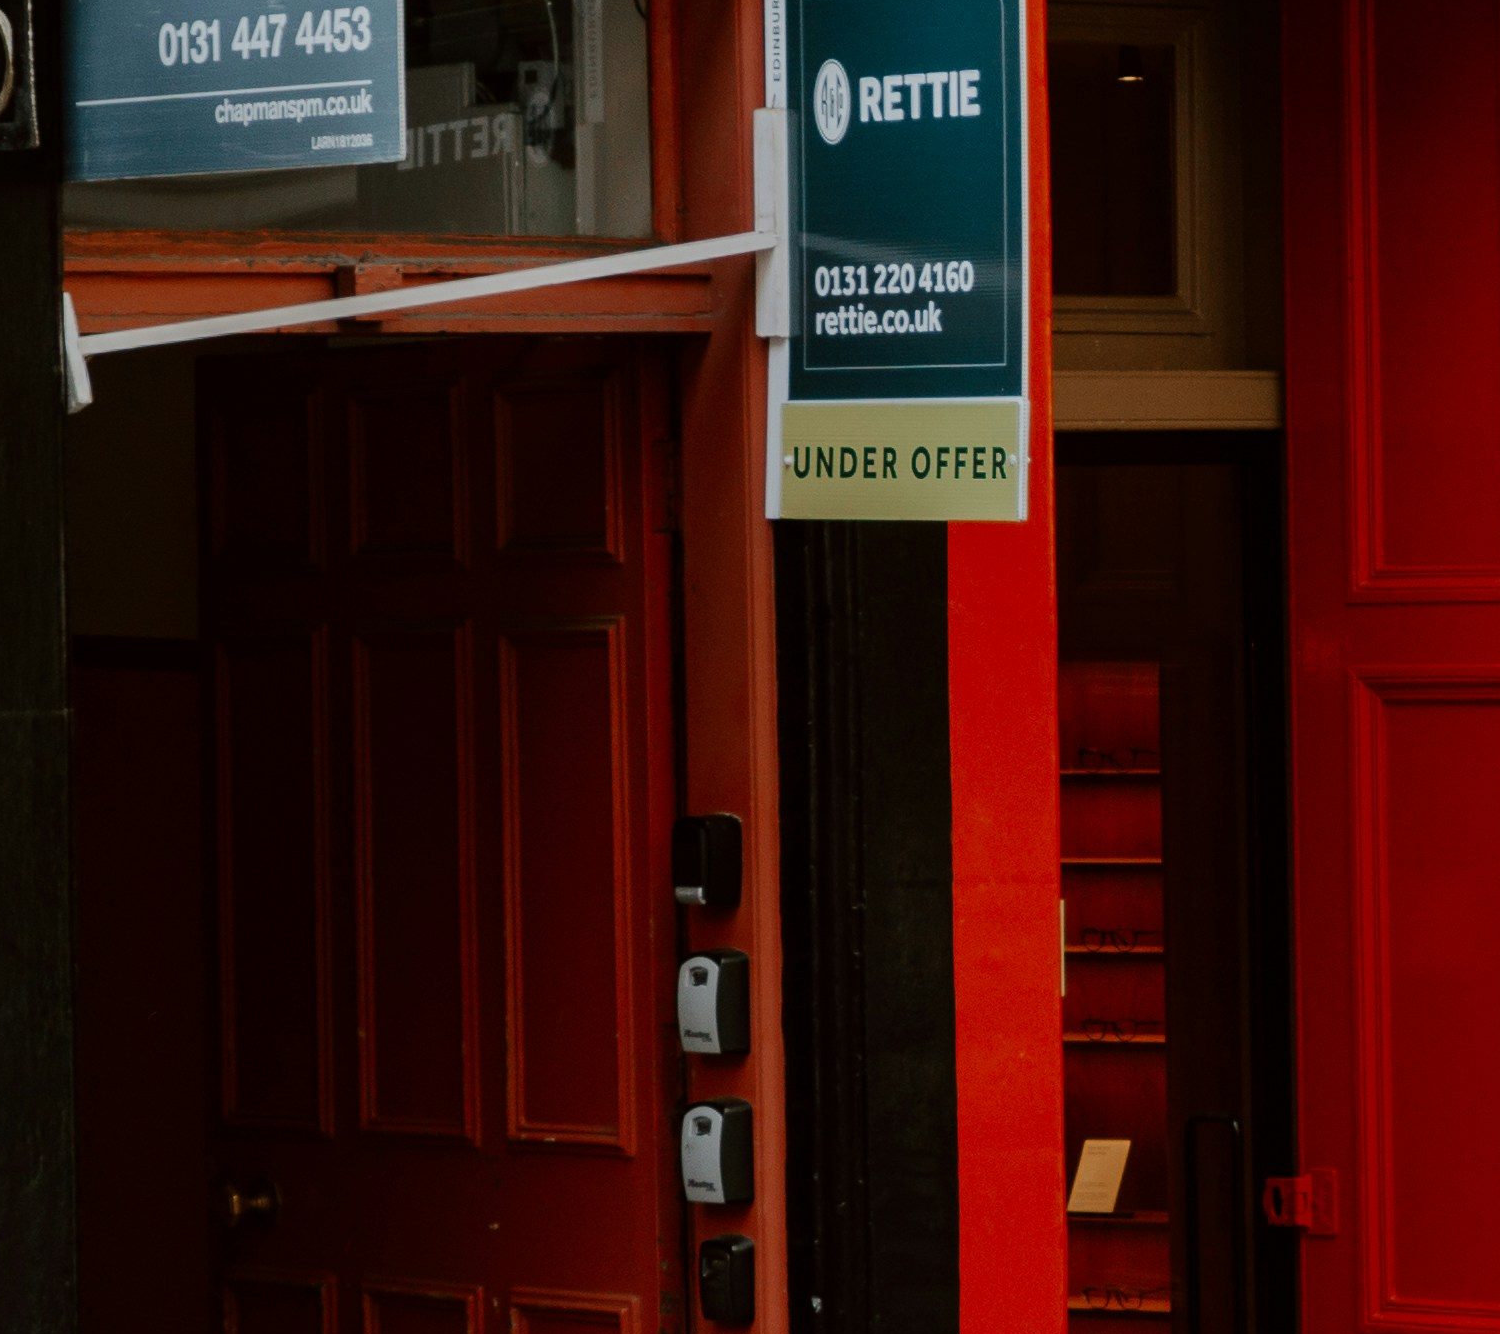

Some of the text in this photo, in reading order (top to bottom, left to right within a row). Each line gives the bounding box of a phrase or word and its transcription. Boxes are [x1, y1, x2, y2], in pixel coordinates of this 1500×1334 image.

[158, 6, 371, 67] 0131 447 4453
[214, 88, 373, 127] chapmanspm.co.uk
[859, 69, 981, 123] RETTIE
[815, 260, 974, 297] 0131 220 4160
[815, 301, 942, 335] rettie.co.uk
[794, 446, 1008, 480] UNDER OFFER
